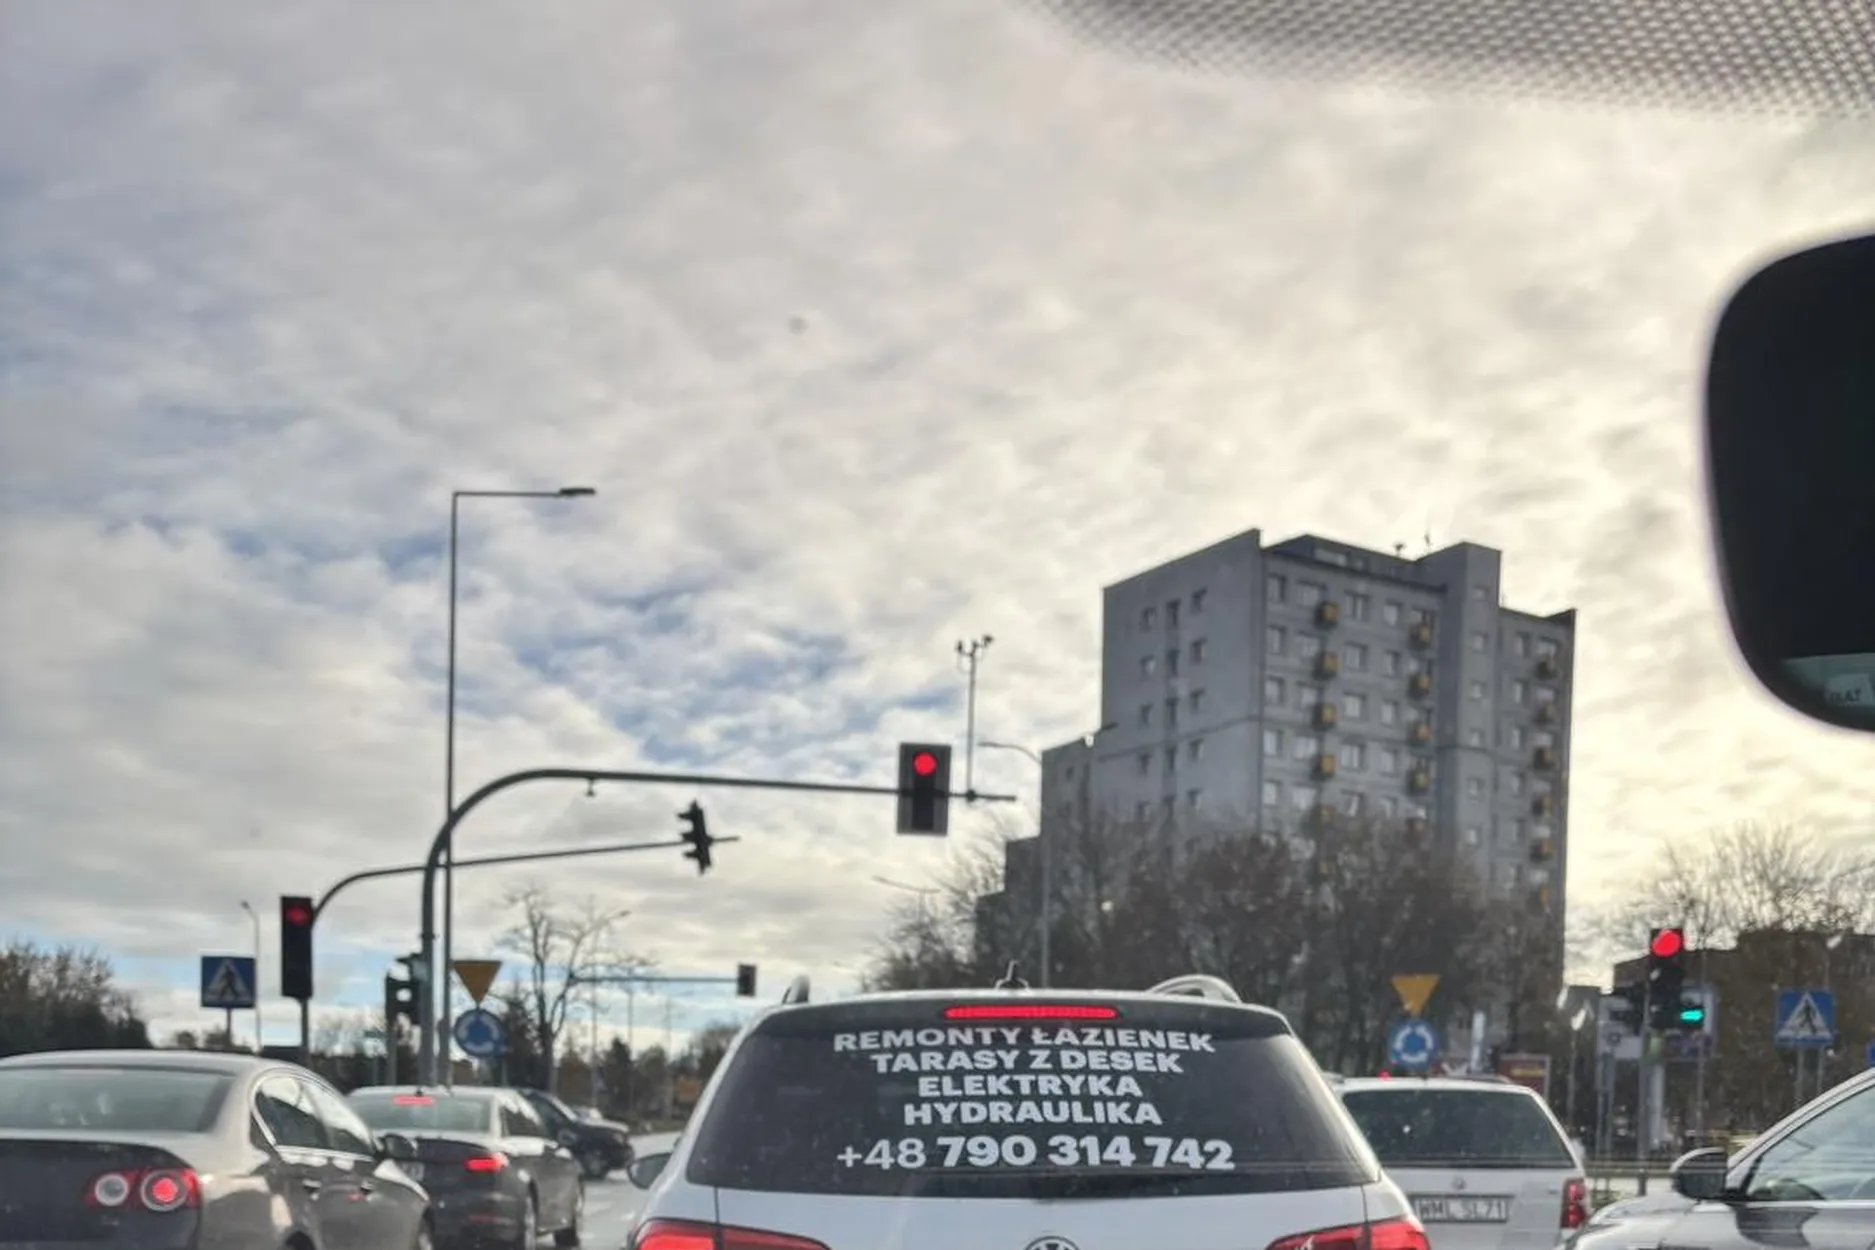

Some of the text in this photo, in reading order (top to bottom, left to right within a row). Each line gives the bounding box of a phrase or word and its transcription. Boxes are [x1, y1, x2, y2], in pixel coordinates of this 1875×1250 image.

[834, 1028, 1216, 1053] REMONTY ŁAZIENEK
[871, 1051, 1184, 1074] TARASY Z DESEK
[918, 1075, 1143, 1098] ELEKTRYKA
[904, 1102, 1163, 1126] HYDRAULIKA
[836, 1135, 1236, 1170] +48 790 314 742
